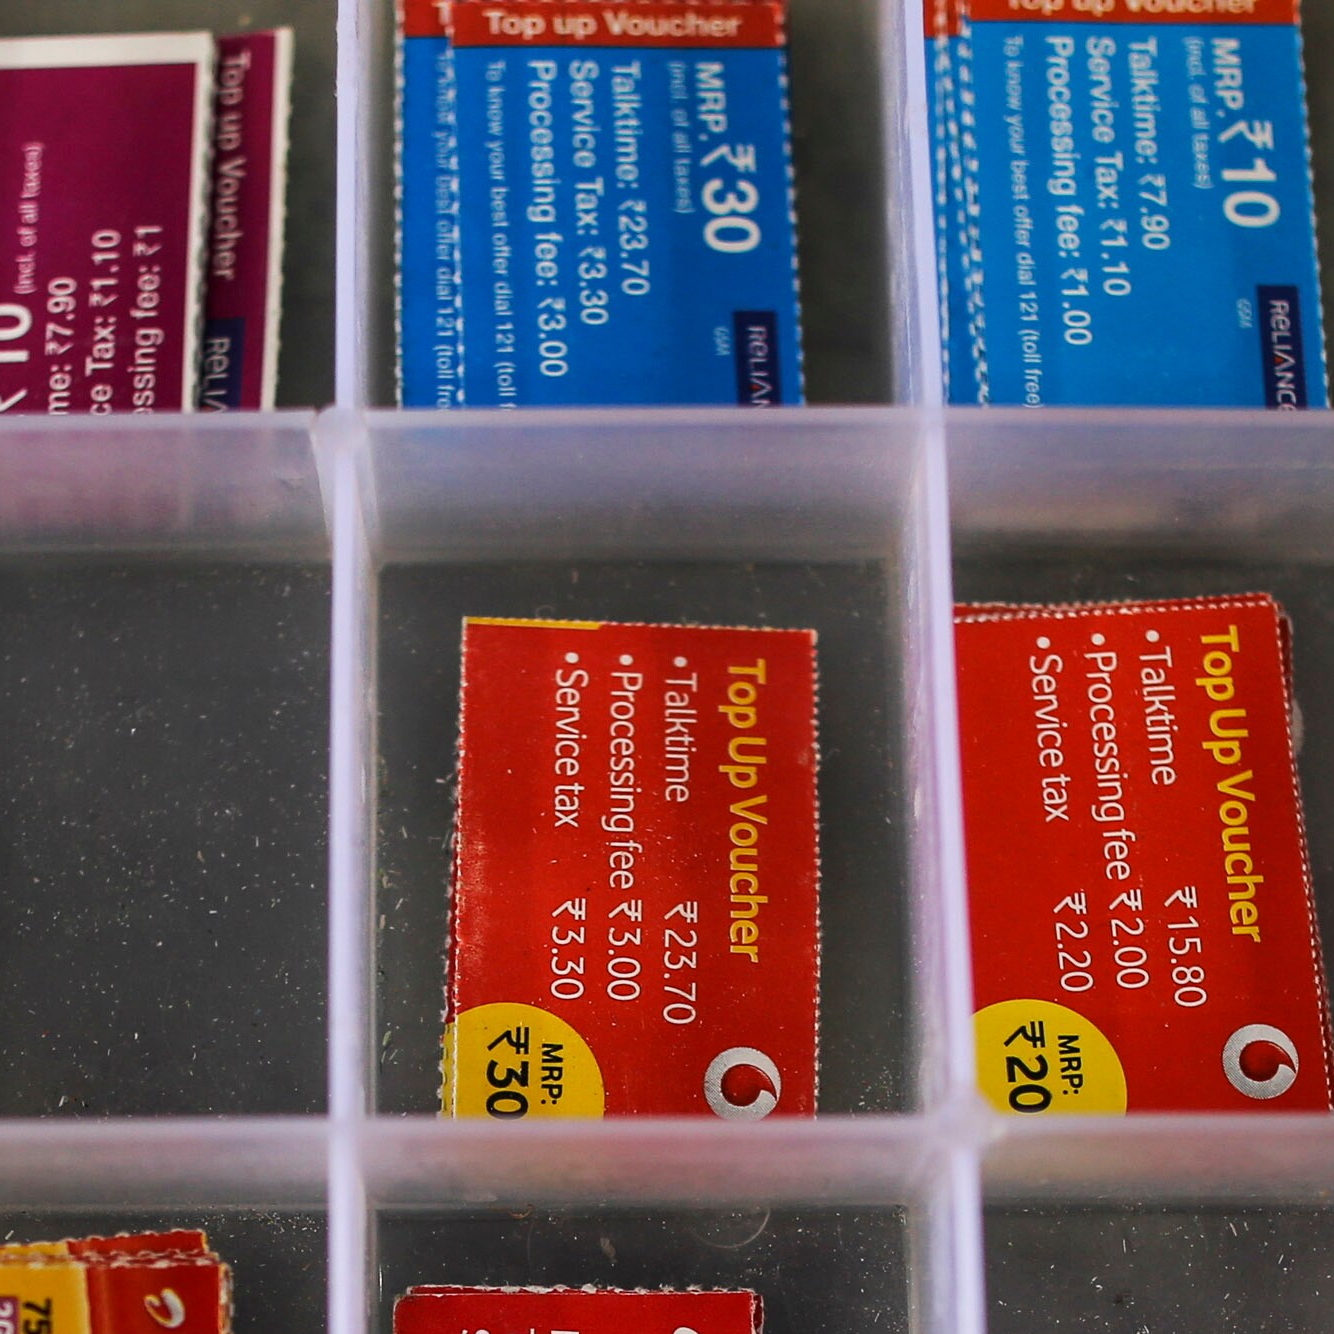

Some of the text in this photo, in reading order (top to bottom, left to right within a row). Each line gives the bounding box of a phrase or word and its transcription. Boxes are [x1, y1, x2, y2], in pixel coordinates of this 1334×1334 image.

[484, 9, 740, 40] Top up Voucher
[211, 50, 252, 281] Top up Voucher
[611, 60, 650, 296] Talktime: ₹23.70
[1086, 36, 1131, 297] Service Tax: ₹1.10
[1127, 37, 1170, 251] Talktime: ₹7.90
[526, 59, 568, 377] Processing fee: ₹3.00
[568, 59, 609, 325] Service Tax: ₹3.30
[1012, 205, 1034, 247] offer
[1045, 36, 1092, 346] Processing fee: ₹1.00
[130, 265, 162, 318] fee:
[1016, 252, 1037, 286] dial
[1018, 292, 1037, 322] 121
[85, 317, 115, 376] Tax:
[1016, 329, 1040, 364] (toll
[554, 669, 589, 776] Service
[601, 671, 643, 832] Processing
[1028, 654, 1066, 768] Service
[1083, 651, 1129, 822] Processing
[554, 783, 585, 828] tax
[719, 658, 768, 963] Top Up Voucher
[1041, 774, 1072, 822] tax
[1196, 625, 1265, 943] Top Up Voucher
[608, 841, 642, 890] fee
[1102, 829, 1136, 880] fee
[540, 1043, 564, 1105] MRP:
[1057, 1034, 1083, 1095] MRP:
